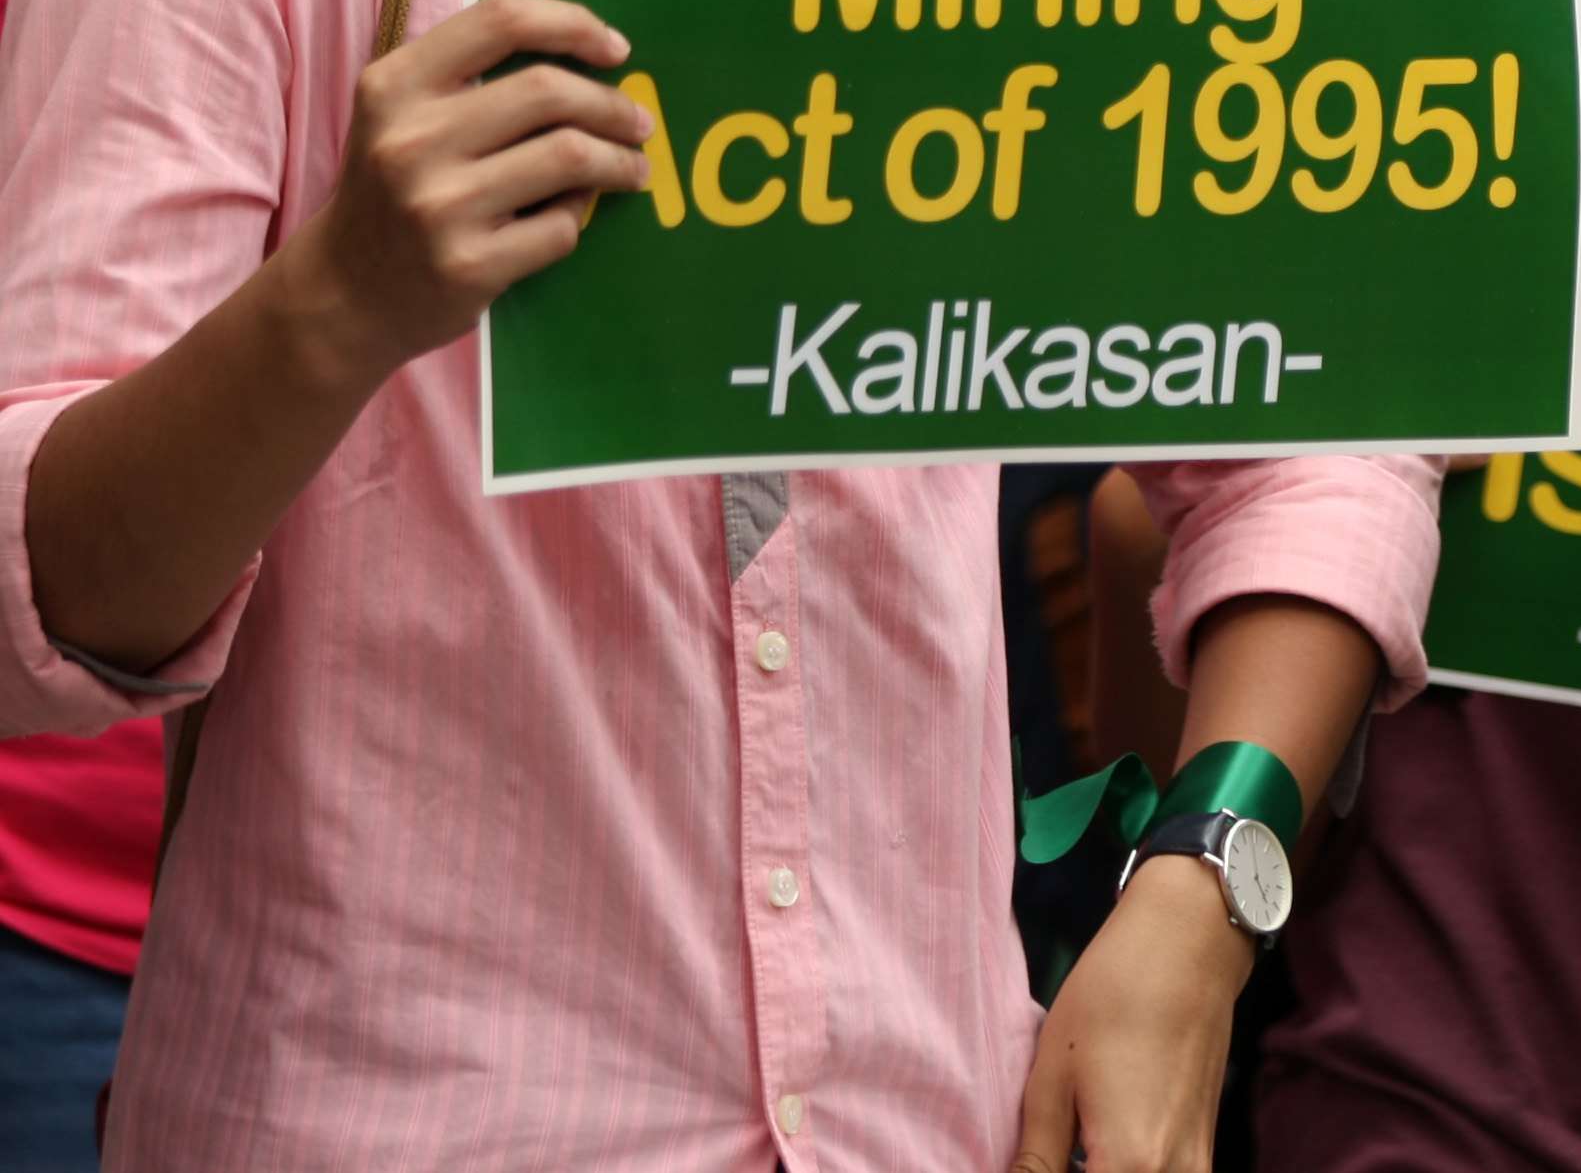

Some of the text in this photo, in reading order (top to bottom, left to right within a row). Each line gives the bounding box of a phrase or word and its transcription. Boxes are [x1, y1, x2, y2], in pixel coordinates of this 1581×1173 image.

[578, 53, 1520, 229] Act of 1995!
[729, 299, 1323, 416] -Kalikasan-
